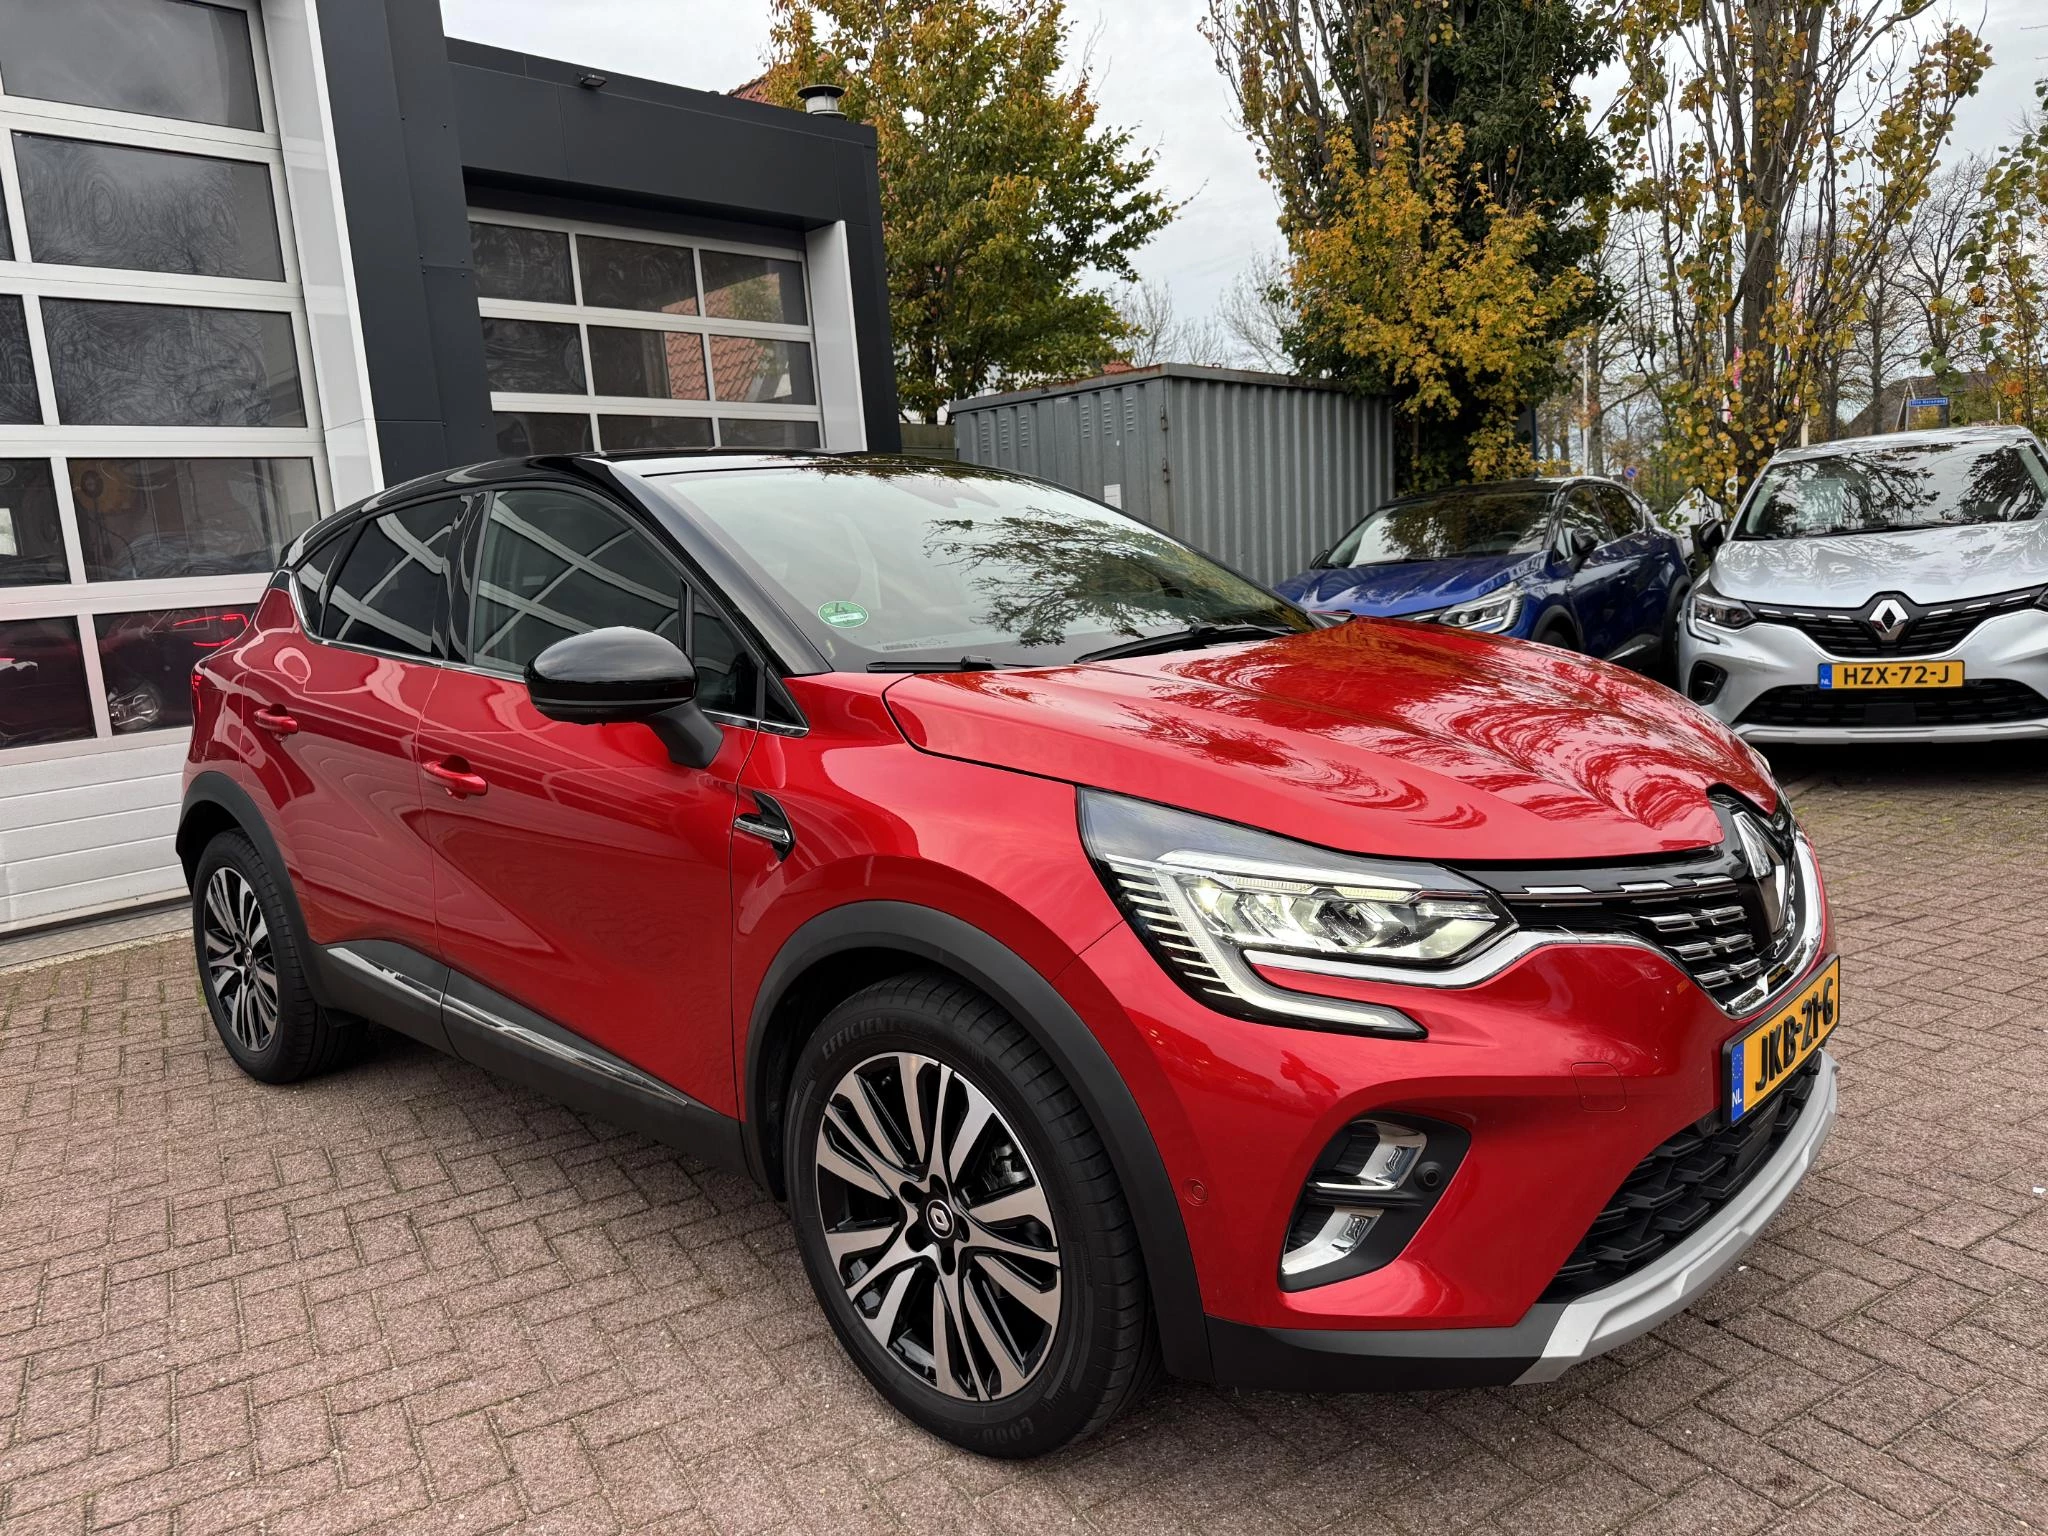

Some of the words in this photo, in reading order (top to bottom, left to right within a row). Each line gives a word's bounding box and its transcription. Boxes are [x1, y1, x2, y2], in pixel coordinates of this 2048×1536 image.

[1843, 665, 1950, 685] HZX-72-J
[1755, 977, 1833, 1091] JKB-21-G
[1731, 1088, 1743, 1107] NL
